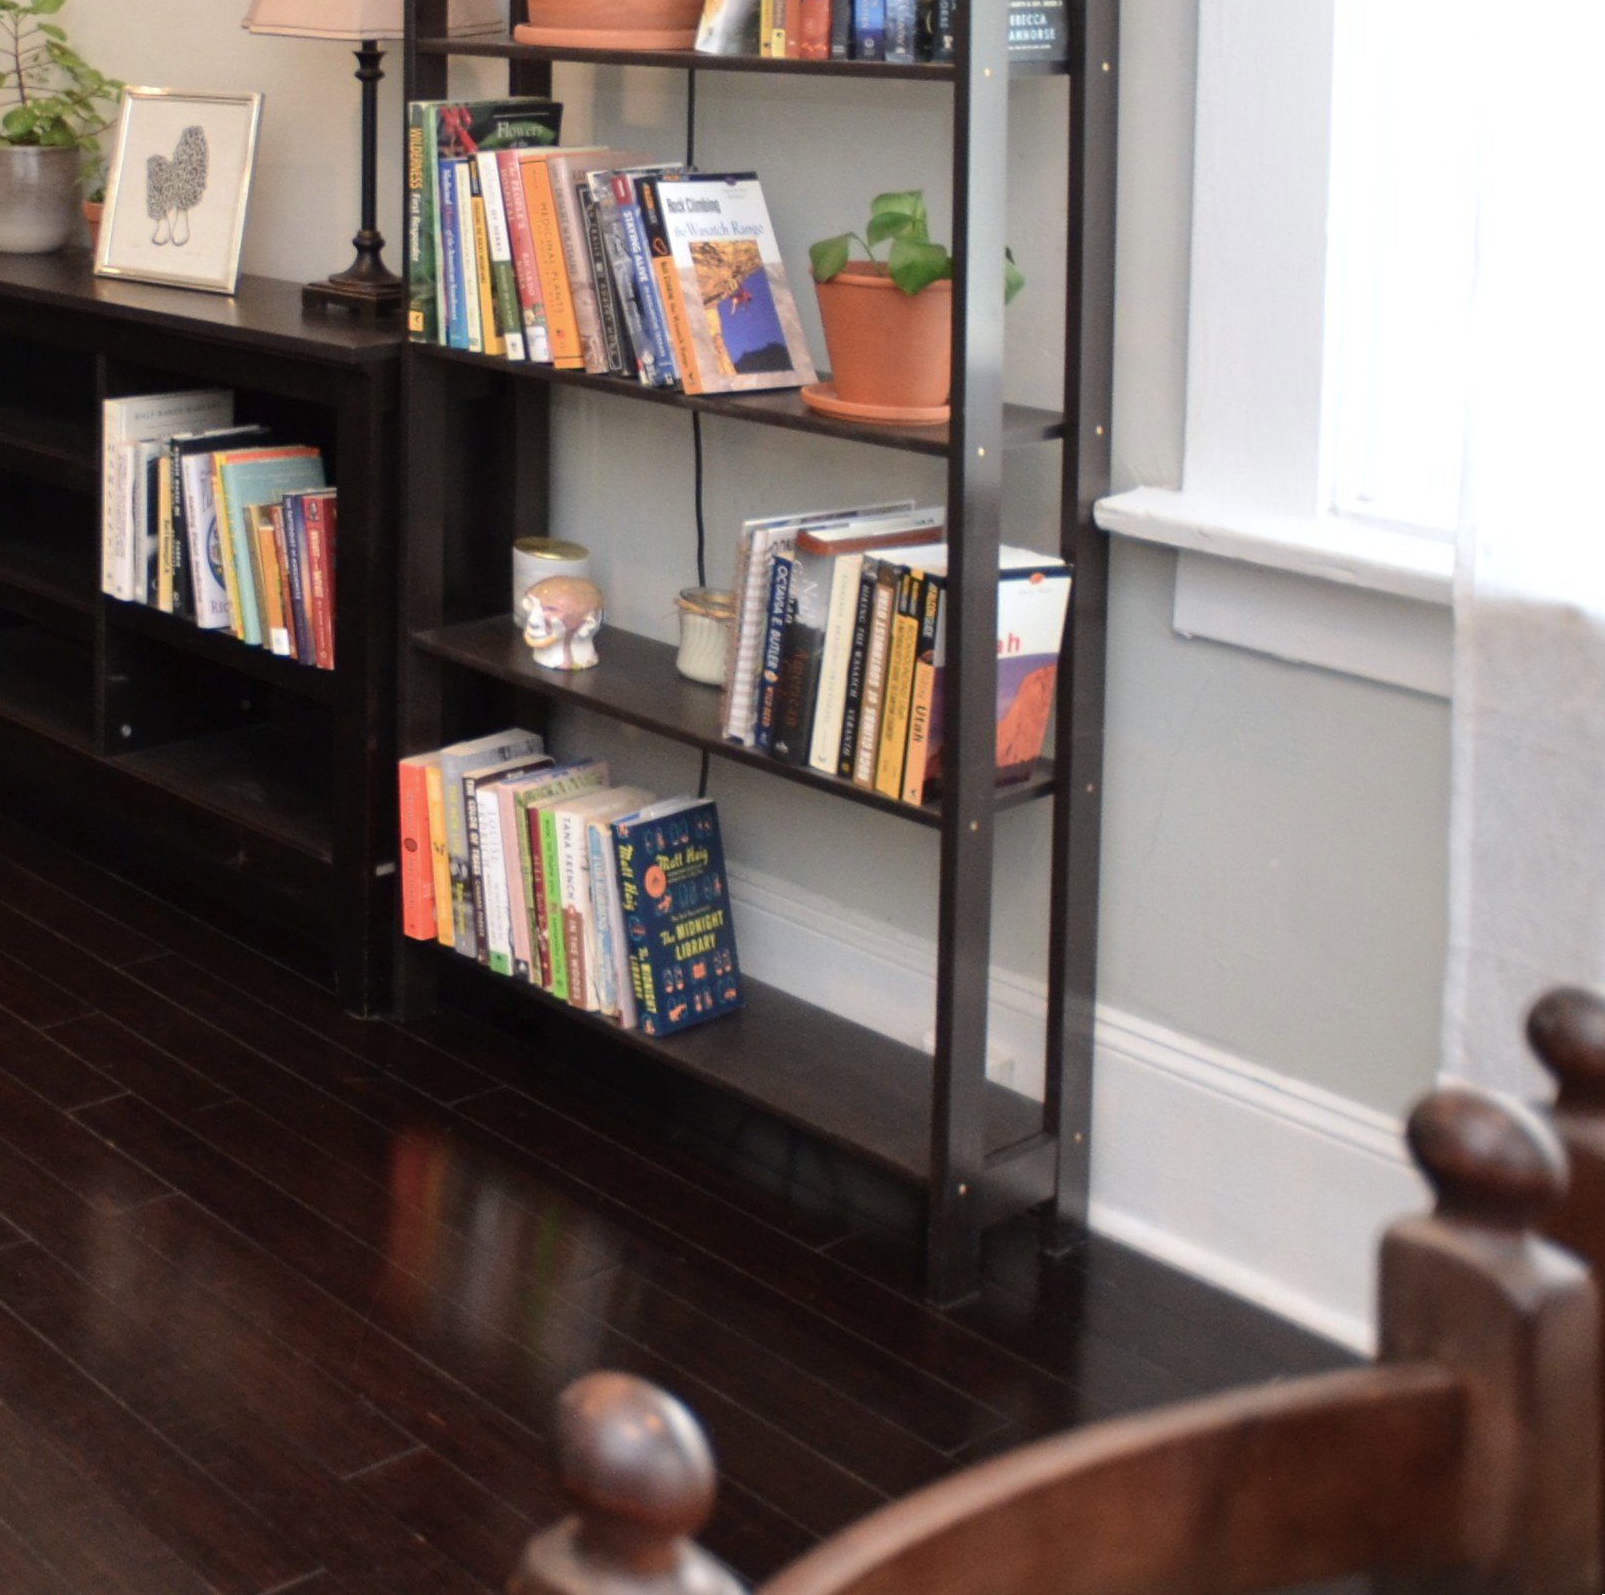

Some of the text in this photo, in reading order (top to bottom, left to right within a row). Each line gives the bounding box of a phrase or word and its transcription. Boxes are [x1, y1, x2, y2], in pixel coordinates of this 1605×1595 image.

[497, 121, 544, 139] Flowers
[409, 128, 424, 262] WILDERNESS First Responder
[622, 210, 642, 254] STAYING
[633, 254, 650, 283] ALIVE
[686, 222, 730, 237] Wasatch
[730, 220, 765, 238] Range
[521, 252, 536, 297] RICARDO
[540, 202, 557, 266] MEDICINAL
[550, 270, 565, 315] PLANTS
[773, 565, 788, 615] OCTAVIA
[873, 589, 890, 620] UTAH
[766, 628, 781, 668] BUTLER
[849, 584, 871, 699] HIKING THE WASATCH
[868, 620, 887, 687] SOUTHWEST
[860, 708, 877, 746] CLIMBS
[911, 705, 928, 743] Utah
[858, 748, 873, 782] ROCK
[465, 778, 476, 797] THE
[467, 799, 479, 829] COLOR
[469, 831, 480, 846] OF
[562, 817, 576, 900] TANA FRENCH
[655, 845, 710, 872] Matt Haig
[619, 844, 639, 912] Matt Haig
[659, 929, 676, 947] The
[675, 909, 725, 941] MIDNIGHT
[674, 932, 717, 962] LIBRARY
[568, 918, 582, 1001] IN THE WOODS
[630, 954, 644, 1000] LIBRARY
[641, 962, 658, 1015] MIDNIGHT
